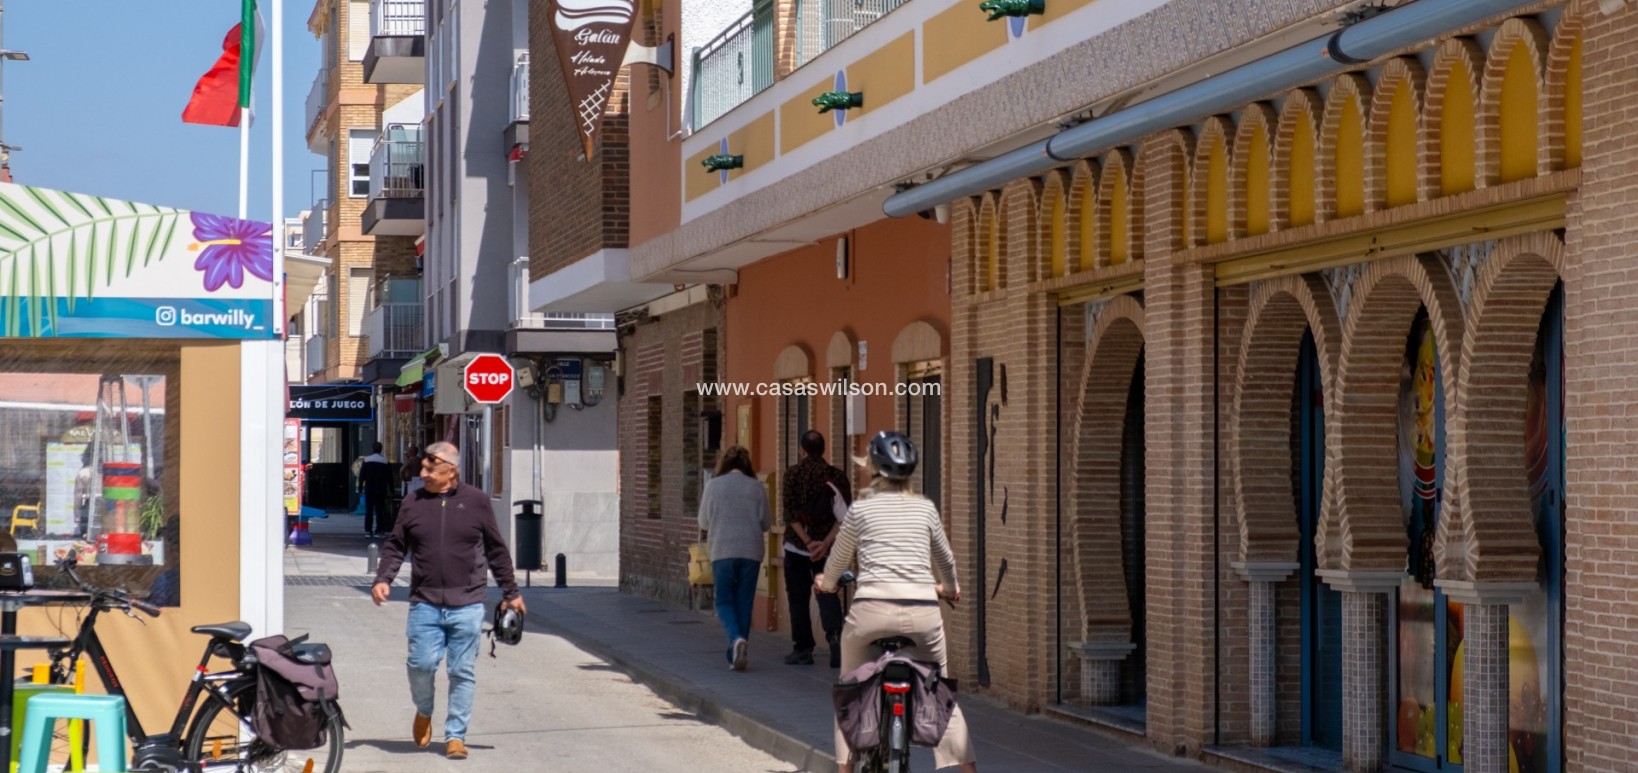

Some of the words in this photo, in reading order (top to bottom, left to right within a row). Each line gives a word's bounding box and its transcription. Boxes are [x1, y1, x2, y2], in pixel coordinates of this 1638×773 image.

[469, 372, 509, 385] STOP
[314, 400, 328, 409] DE
[331, 400, 365, 409] JUEGO
